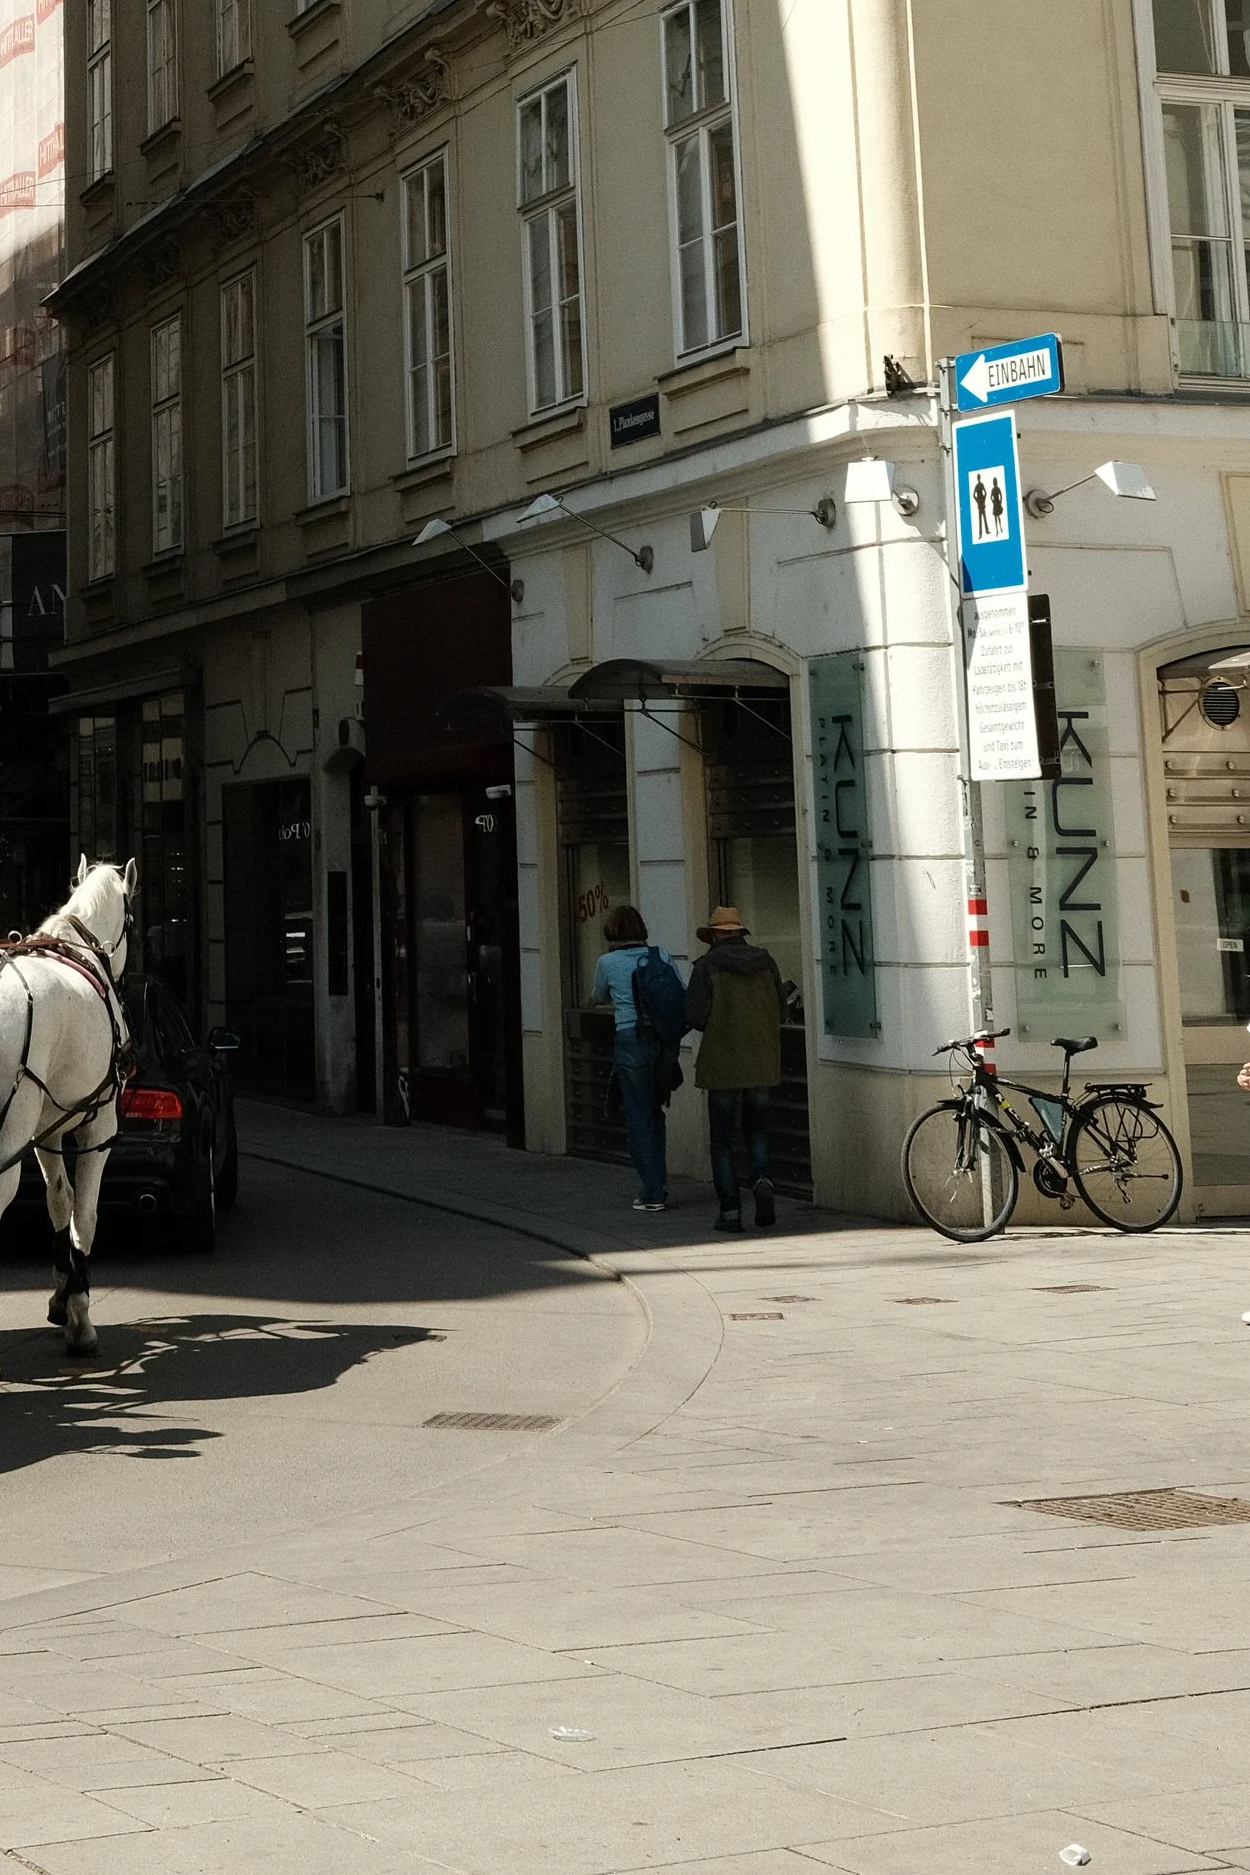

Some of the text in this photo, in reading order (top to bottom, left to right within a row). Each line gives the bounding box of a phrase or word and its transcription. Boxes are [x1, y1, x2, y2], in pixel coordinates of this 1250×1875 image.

[988, 353, 1046, 387] EINBAHN
[818, 717, 830, 823] PLATIN
[825, 886, 837, 975] MORE
[831, 715, 865, 976] KUNZ
[1027, 846, 1039, 861] &
[1052, 711, 1106, 979] KUNZ
[1029, 886, 1048, 979] MORE
[1222, 940, 1238, 950] OPEN
